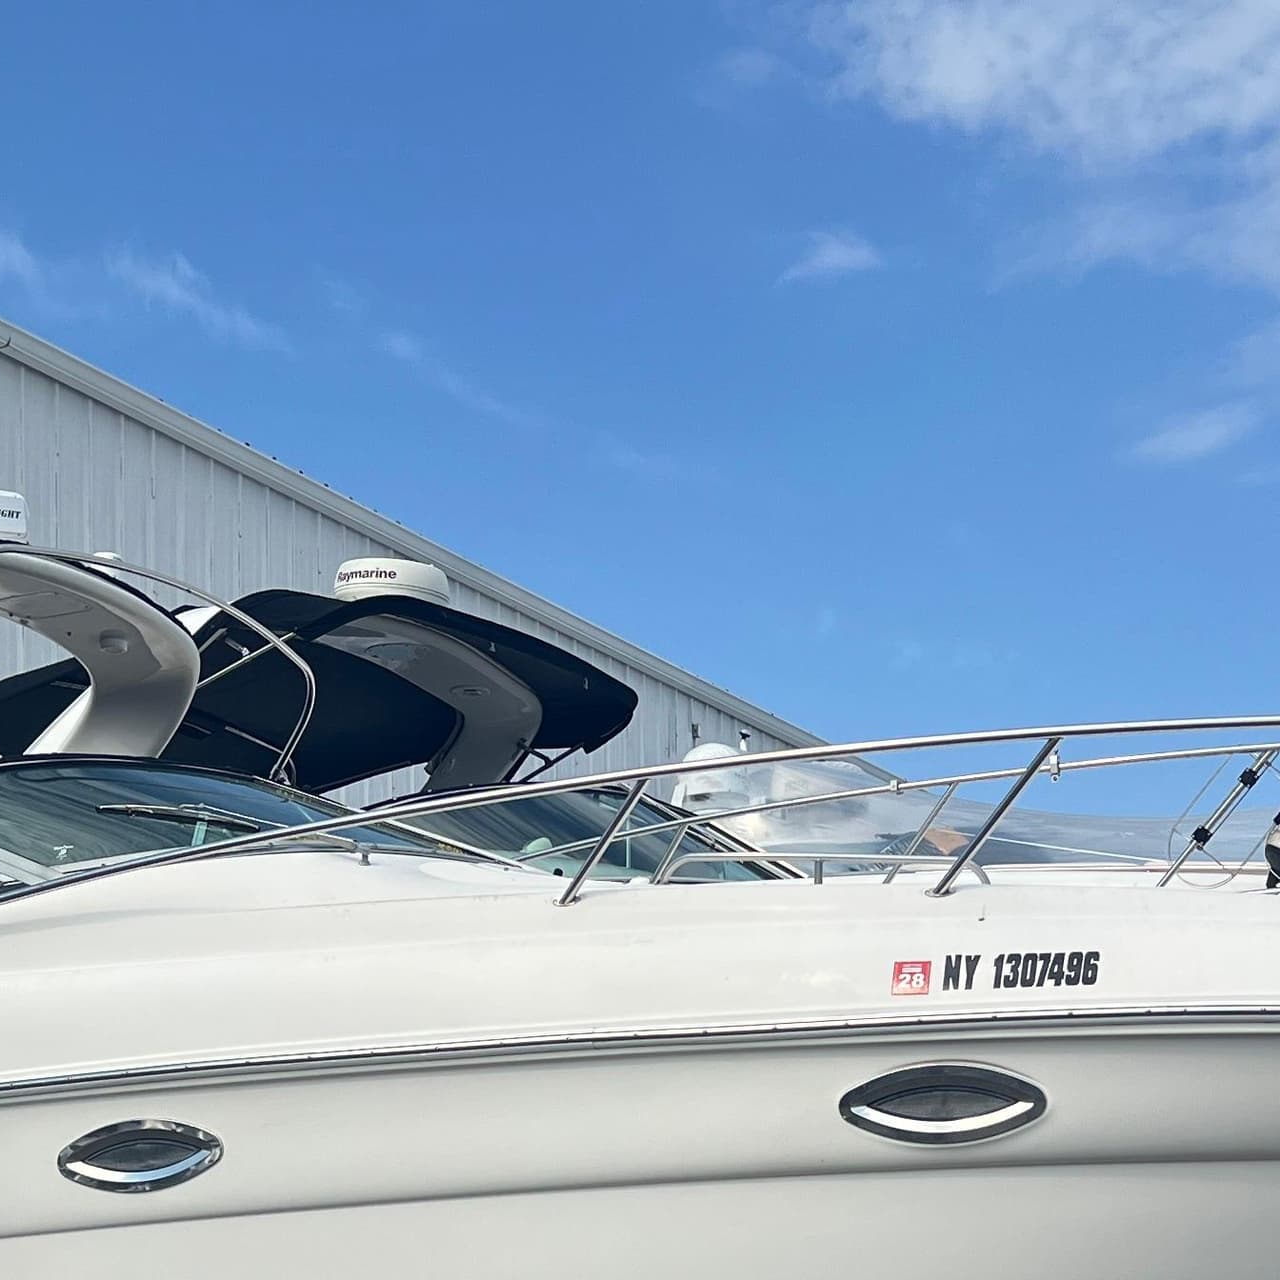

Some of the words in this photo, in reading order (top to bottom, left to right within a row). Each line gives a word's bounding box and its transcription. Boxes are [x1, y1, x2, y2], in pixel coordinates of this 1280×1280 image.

[337, 567, 397, 583] Raymarine
[942, 954, 981, 990] NY
[993, 951, 1100, 989] 1307496
[898, 973, 925, 988] 28
